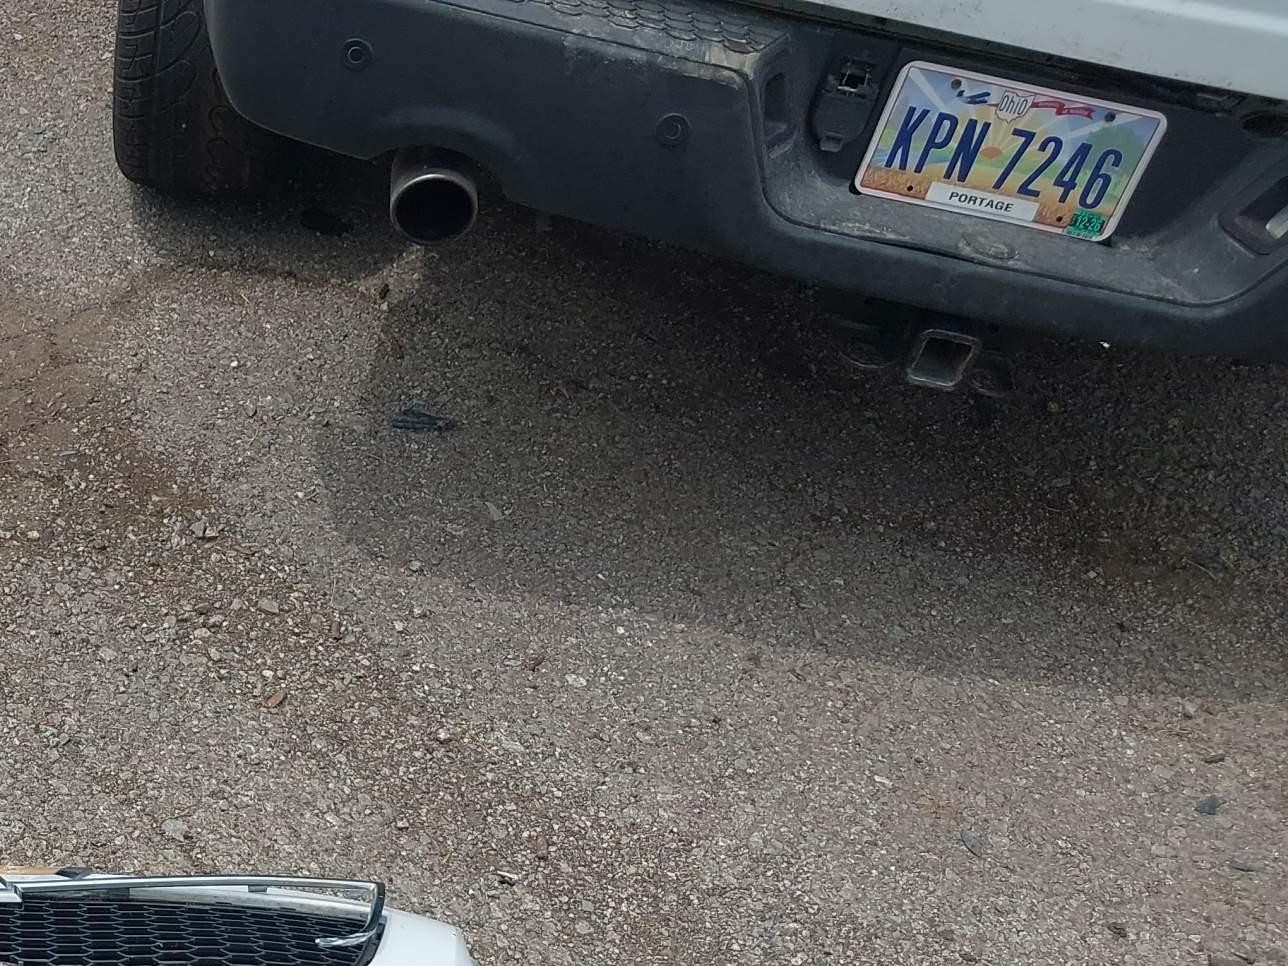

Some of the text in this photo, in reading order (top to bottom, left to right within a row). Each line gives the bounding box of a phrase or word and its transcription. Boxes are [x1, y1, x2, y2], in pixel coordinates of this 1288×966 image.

[885, 106, 1123, 209] KPN 7246
[949, 191, 1015, 213] PORTAGE
